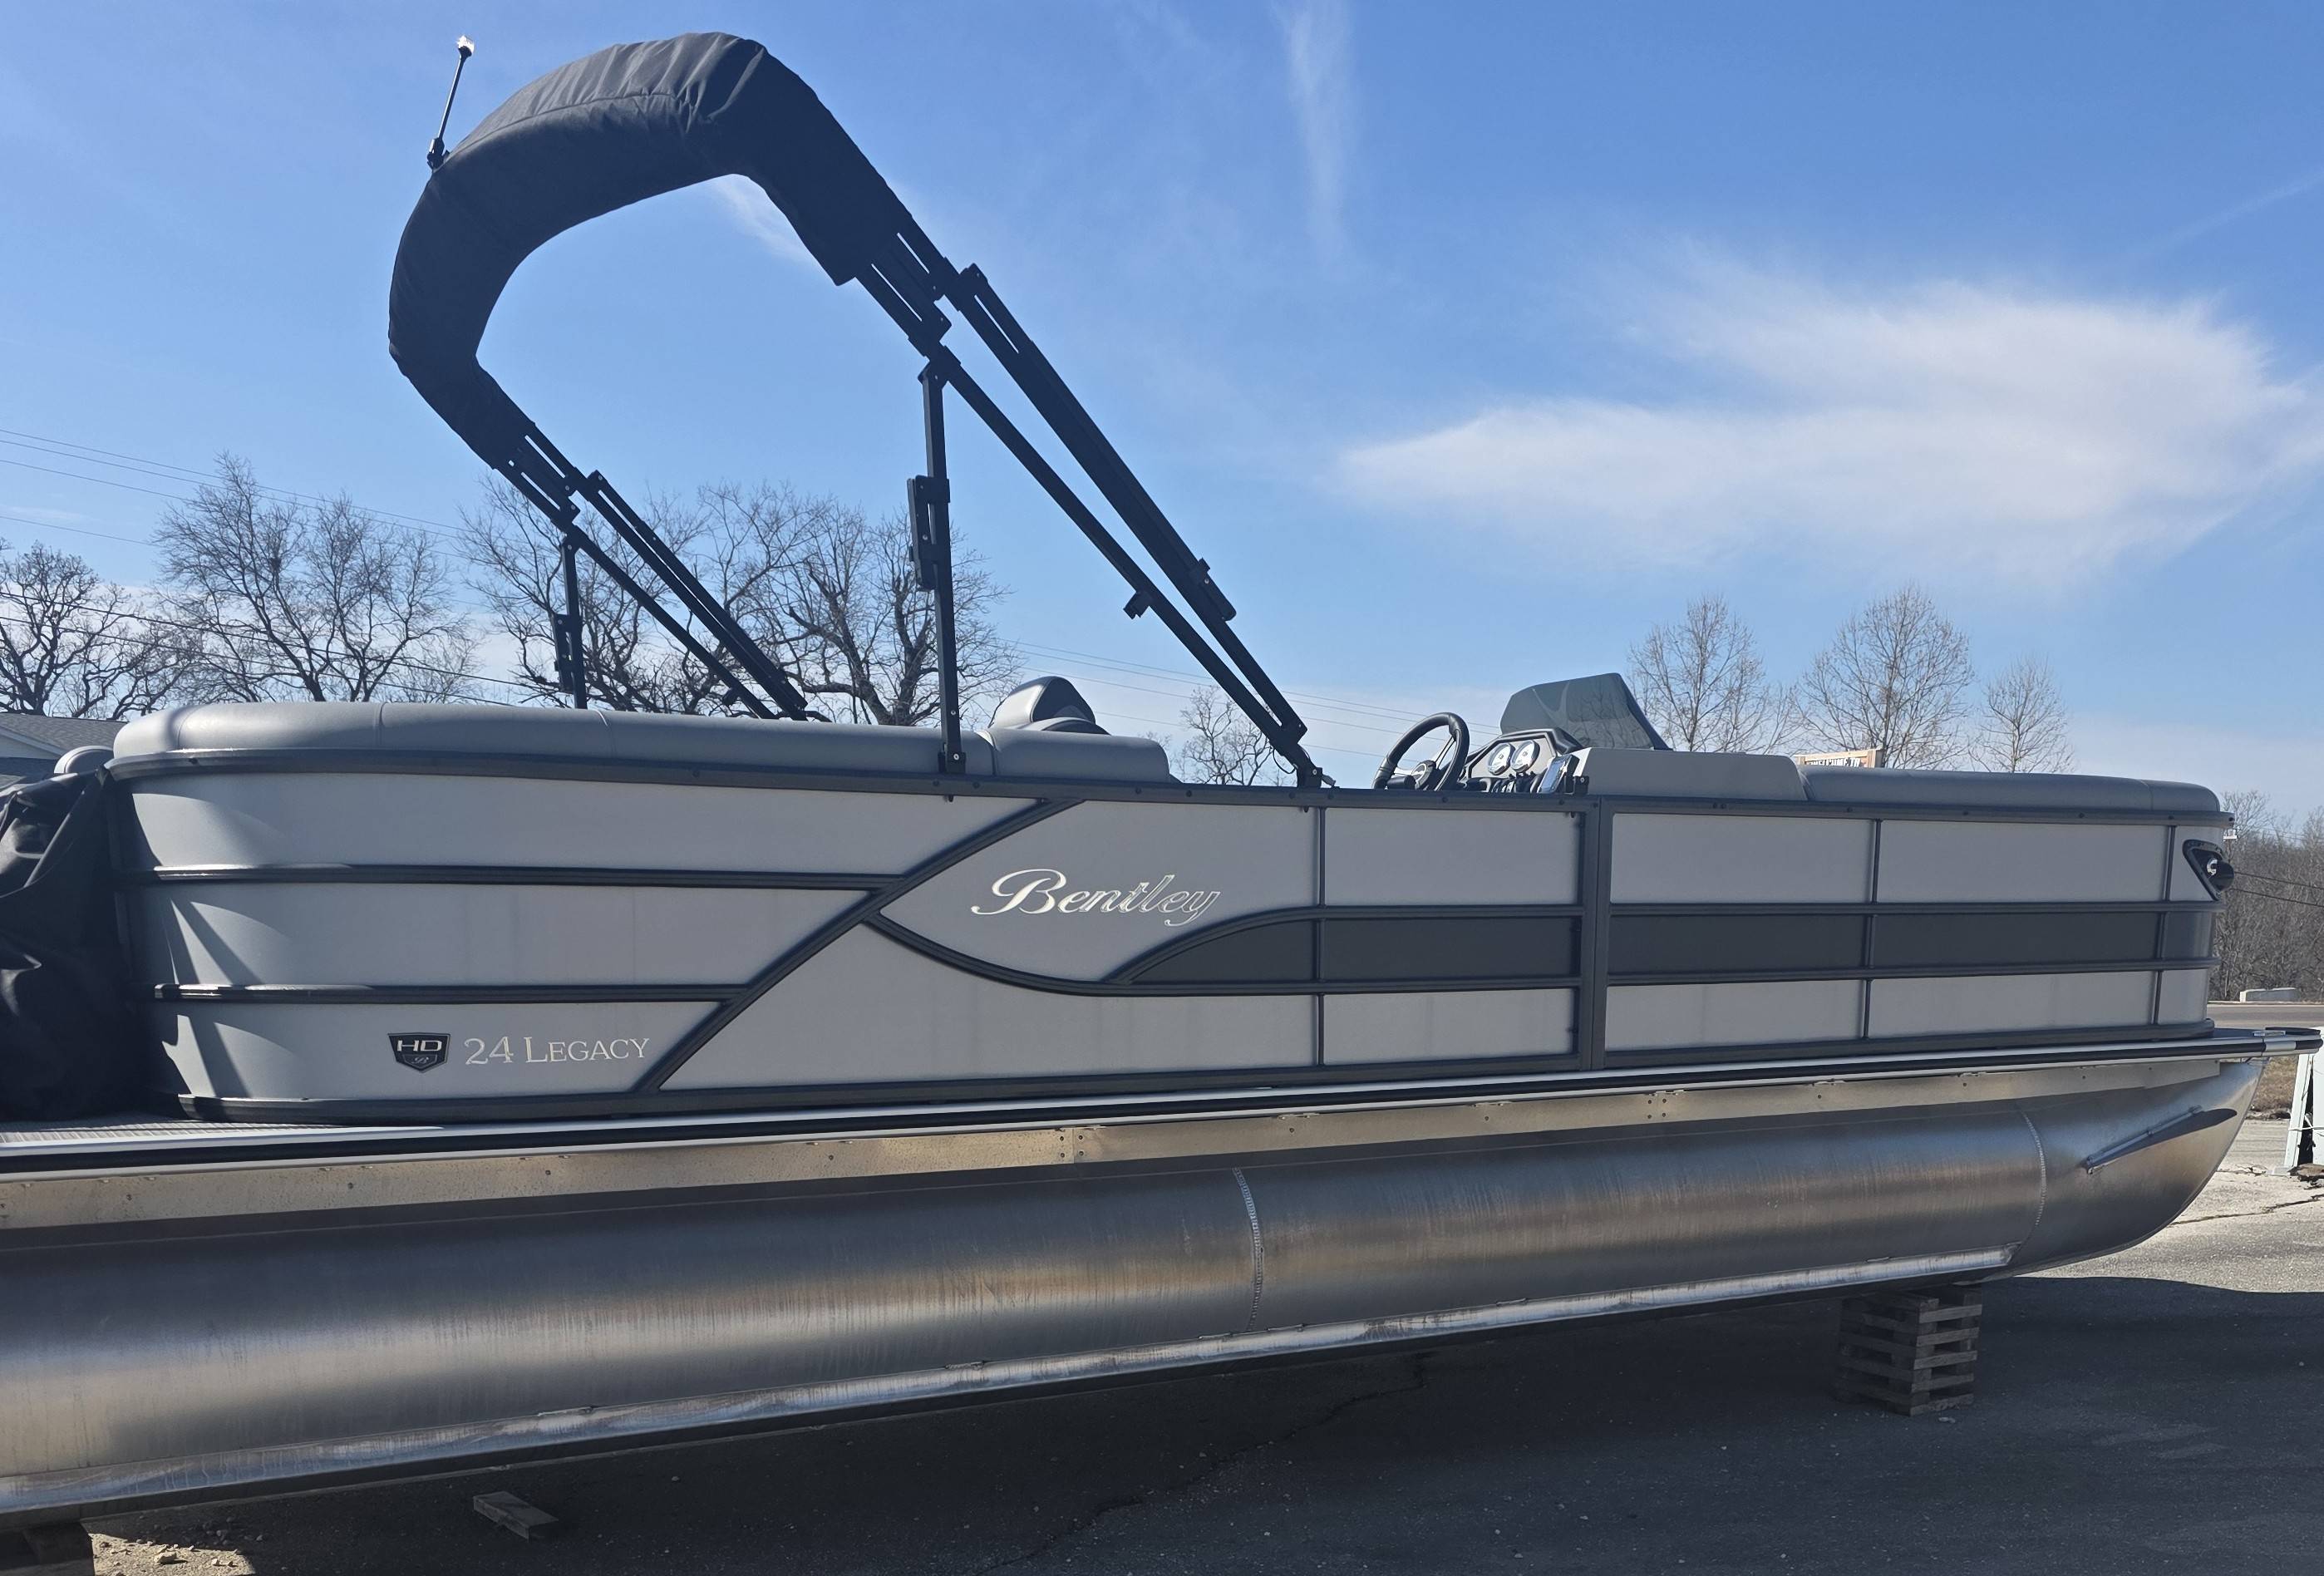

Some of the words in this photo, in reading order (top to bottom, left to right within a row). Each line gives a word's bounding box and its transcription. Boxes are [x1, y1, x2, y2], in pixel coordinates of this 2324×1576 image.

[971, 868, 1221, 926] Bentley
[396, 1040, 442, 1051] HD
[464, 1036, 515, 1065] 24
[523, 1036, 650, 1063] LEGACY
